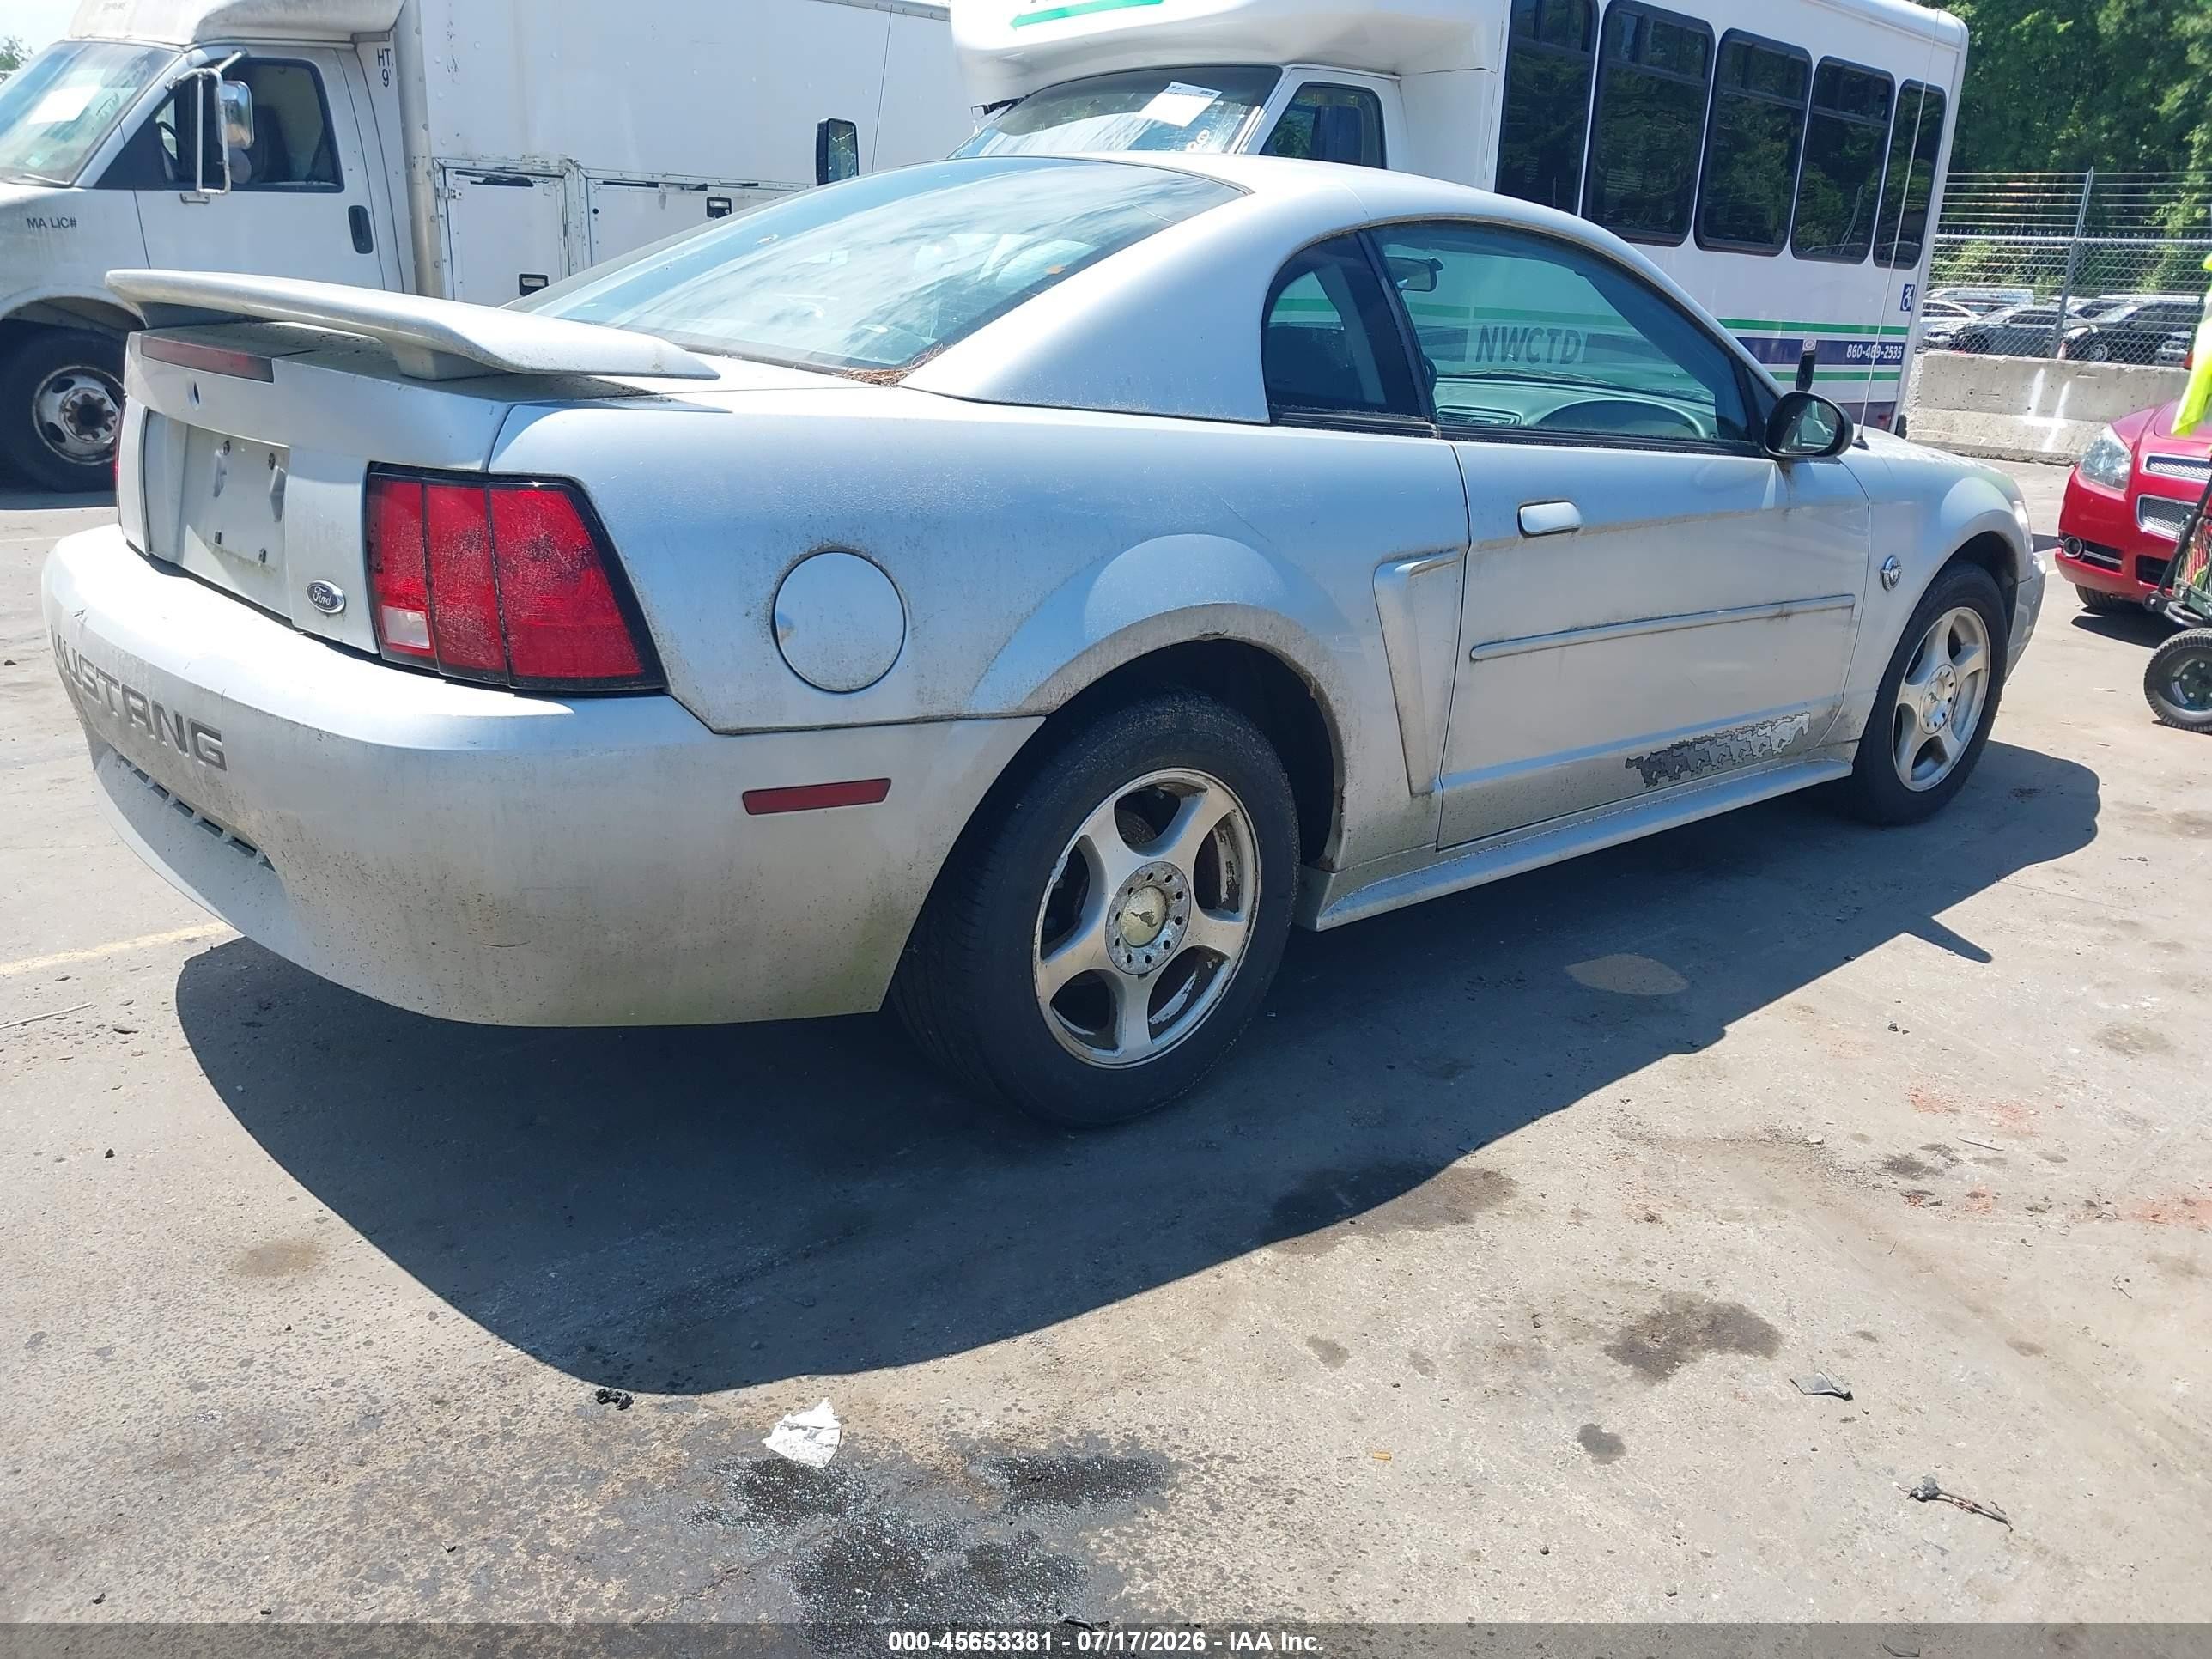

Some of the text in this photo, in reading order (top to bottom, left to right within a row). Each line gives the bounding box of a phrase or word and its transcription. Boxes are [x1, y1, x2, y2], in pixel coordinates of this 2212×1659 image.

[376, 47, 393, 66] HT.
[27, 216, 77, 228] MA LIC#
[1475, 325, 1582, 365] NWCTD
[1846, 343, 1903, 359] 860-489-2535
[313, 586, 332, 606] Ford
[50, 624, 227, 771] MUSTANG
